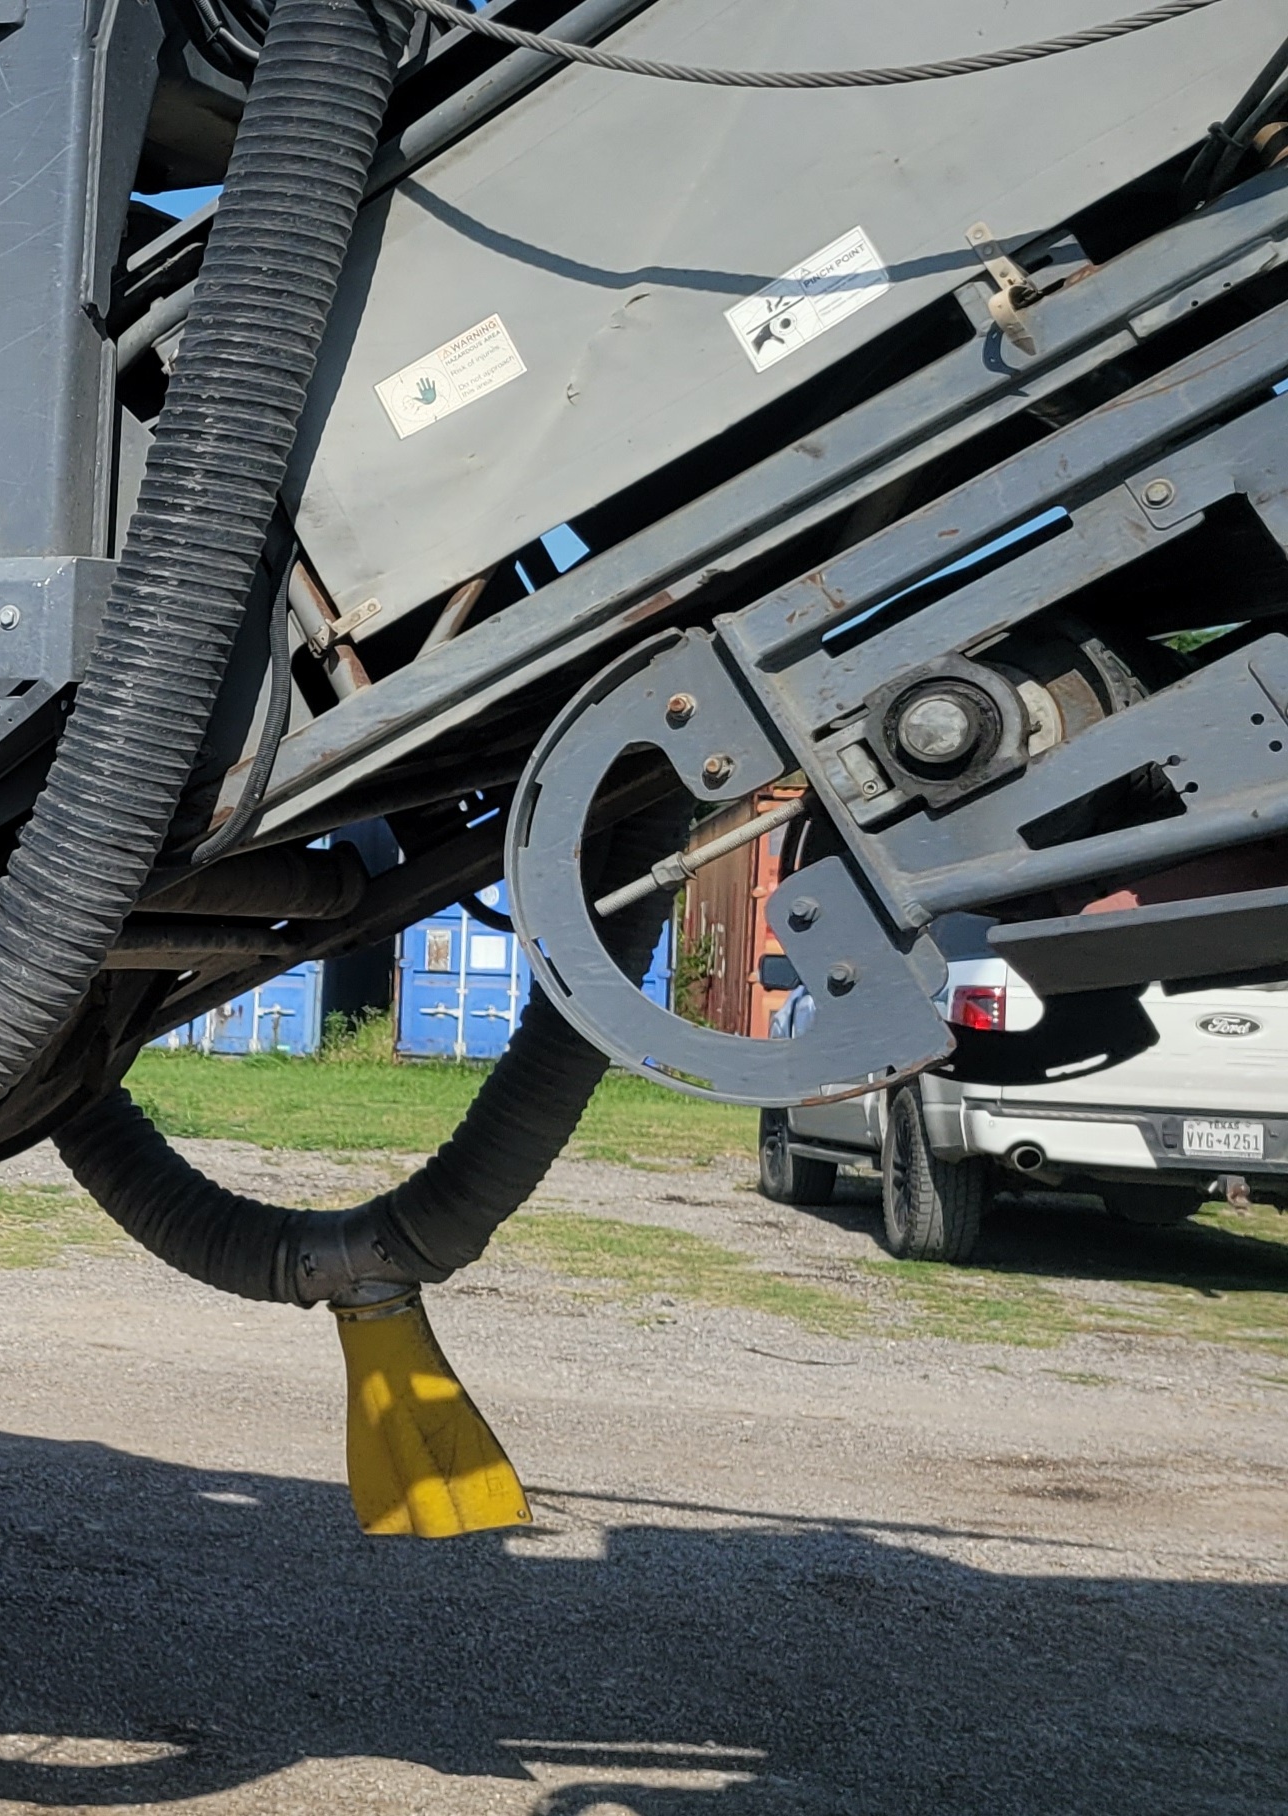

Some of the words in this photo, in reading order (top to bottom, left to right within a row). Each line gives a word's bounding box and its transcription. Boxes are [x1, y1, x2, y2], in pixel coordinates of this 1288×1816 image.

[803, 265, 834, 288] PINCH
[834, 243, 865, 267] POINT
[445, 341, 483, 366] HAZARDOUS
[483, 330, 501, 343] AREA
[450, 320, 497, 352] WARNING
[483, 355, 515, 378] approach
[1207, 1017, 1252, 1034] Ford
[1207, 1119, 1241, 1130] TEXAS
